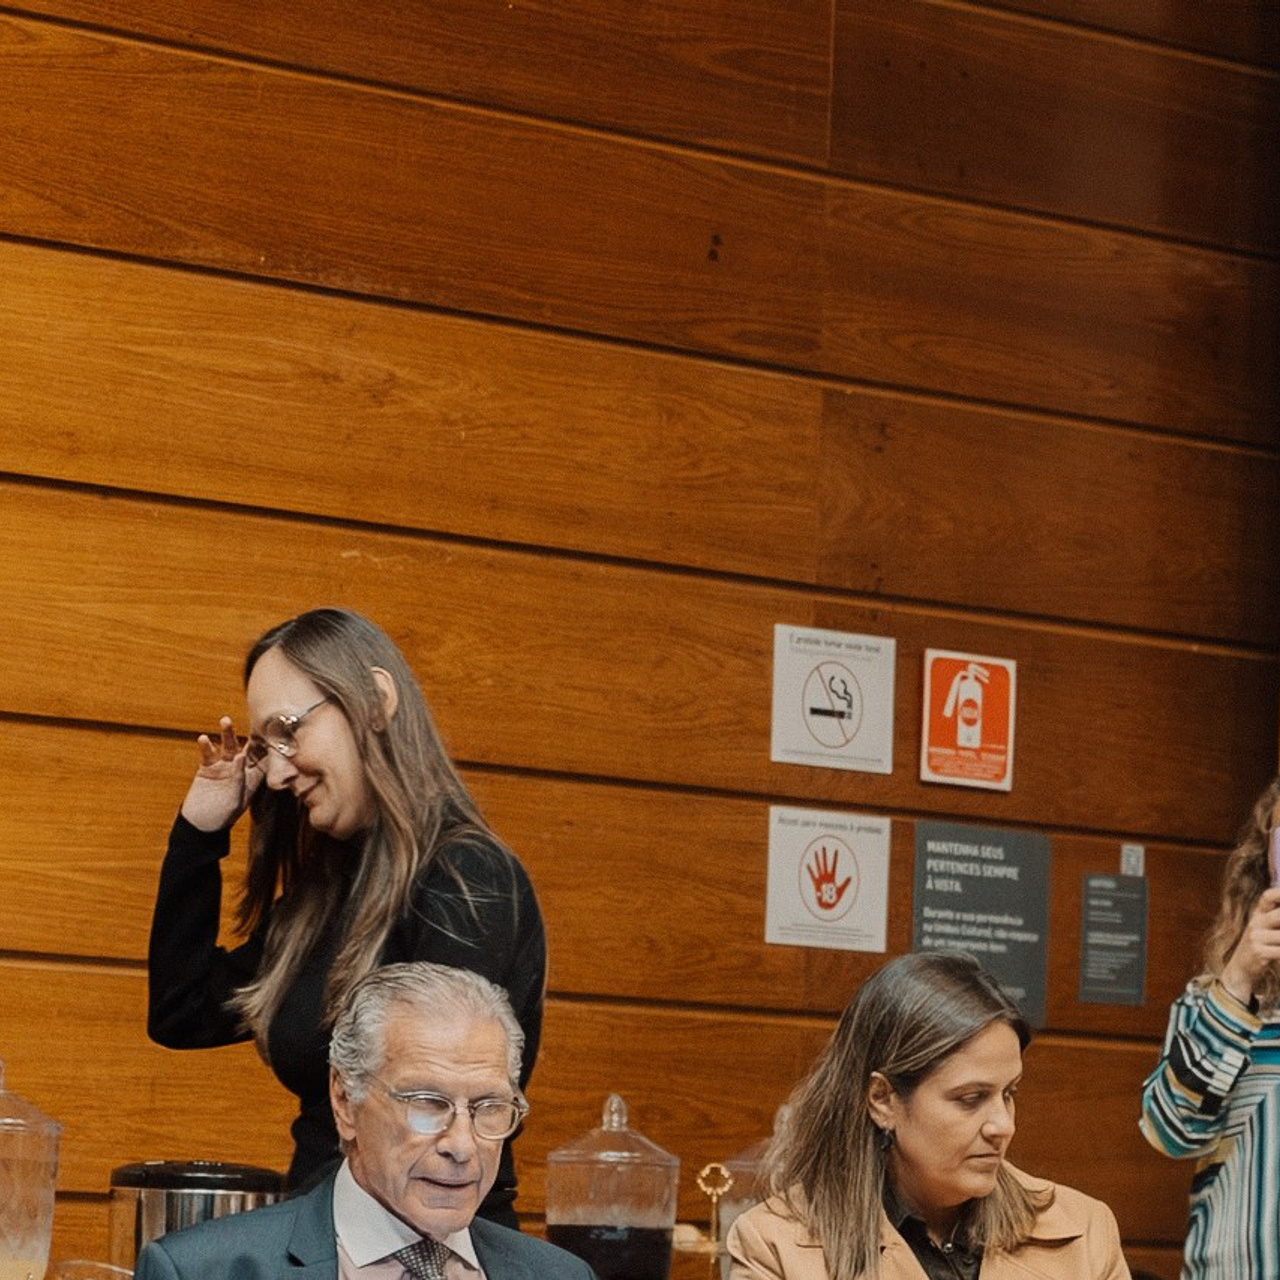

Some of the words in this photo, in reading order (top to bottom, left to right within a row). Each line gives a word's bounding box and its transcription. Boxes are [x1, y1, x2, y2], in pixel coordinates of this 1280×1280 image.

[926, 841, 979, 856] MANTENHA
[981, 846, 1004, 860] SEUS
[926, 860, 980, 876] PERTENCES
[982, 865, 1019, 880] SEMPRE
